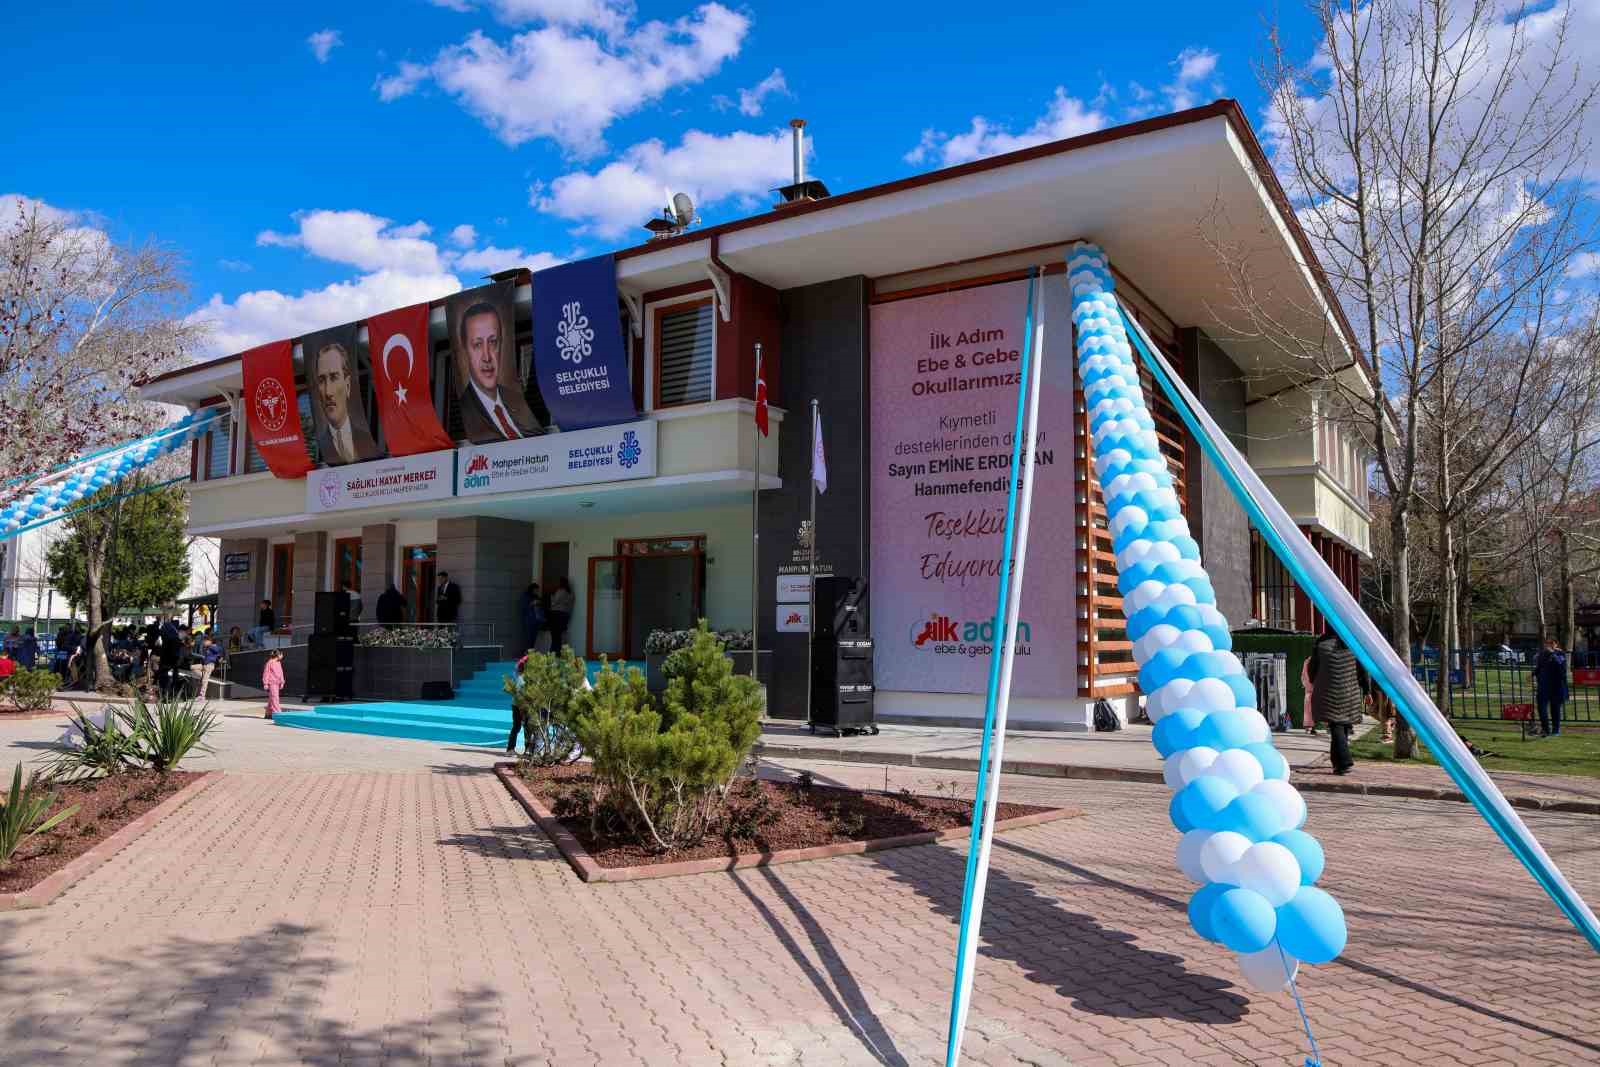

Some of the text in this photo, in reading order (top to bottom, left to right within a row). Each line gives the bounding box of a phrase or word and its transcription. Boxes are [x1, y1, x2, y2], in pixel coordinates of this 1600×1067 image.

[930, 328, 1004, 349] İlk Adım
[917, 348, 1020, 374] Ebe & Gebe
[556, 365, 608, 383] SELÇUKLU
[912, 371, 1022, 396] Okullarımıza
[939, 411, 996, 431] Kıymetli
[569, 444, 613, 458] SELÇUKLU
[895, 432, 999, 455] desteklerinden
[492, 454, 549, 468] Mahperi Hatun
[889, 462, 926, 479] Sayın
[929, 455, 975, 474] EMİNE
[346, 478, 378, 491] SAĞLIKLI
[379, 474, 402, 487] HAYAT
[403, 467, 436, 483] MERKEZİ
[924, 508, 1010, 541] Teşekkü
[934, 643, 956, 655] ebe
[969, 643, 994, 658] geb
